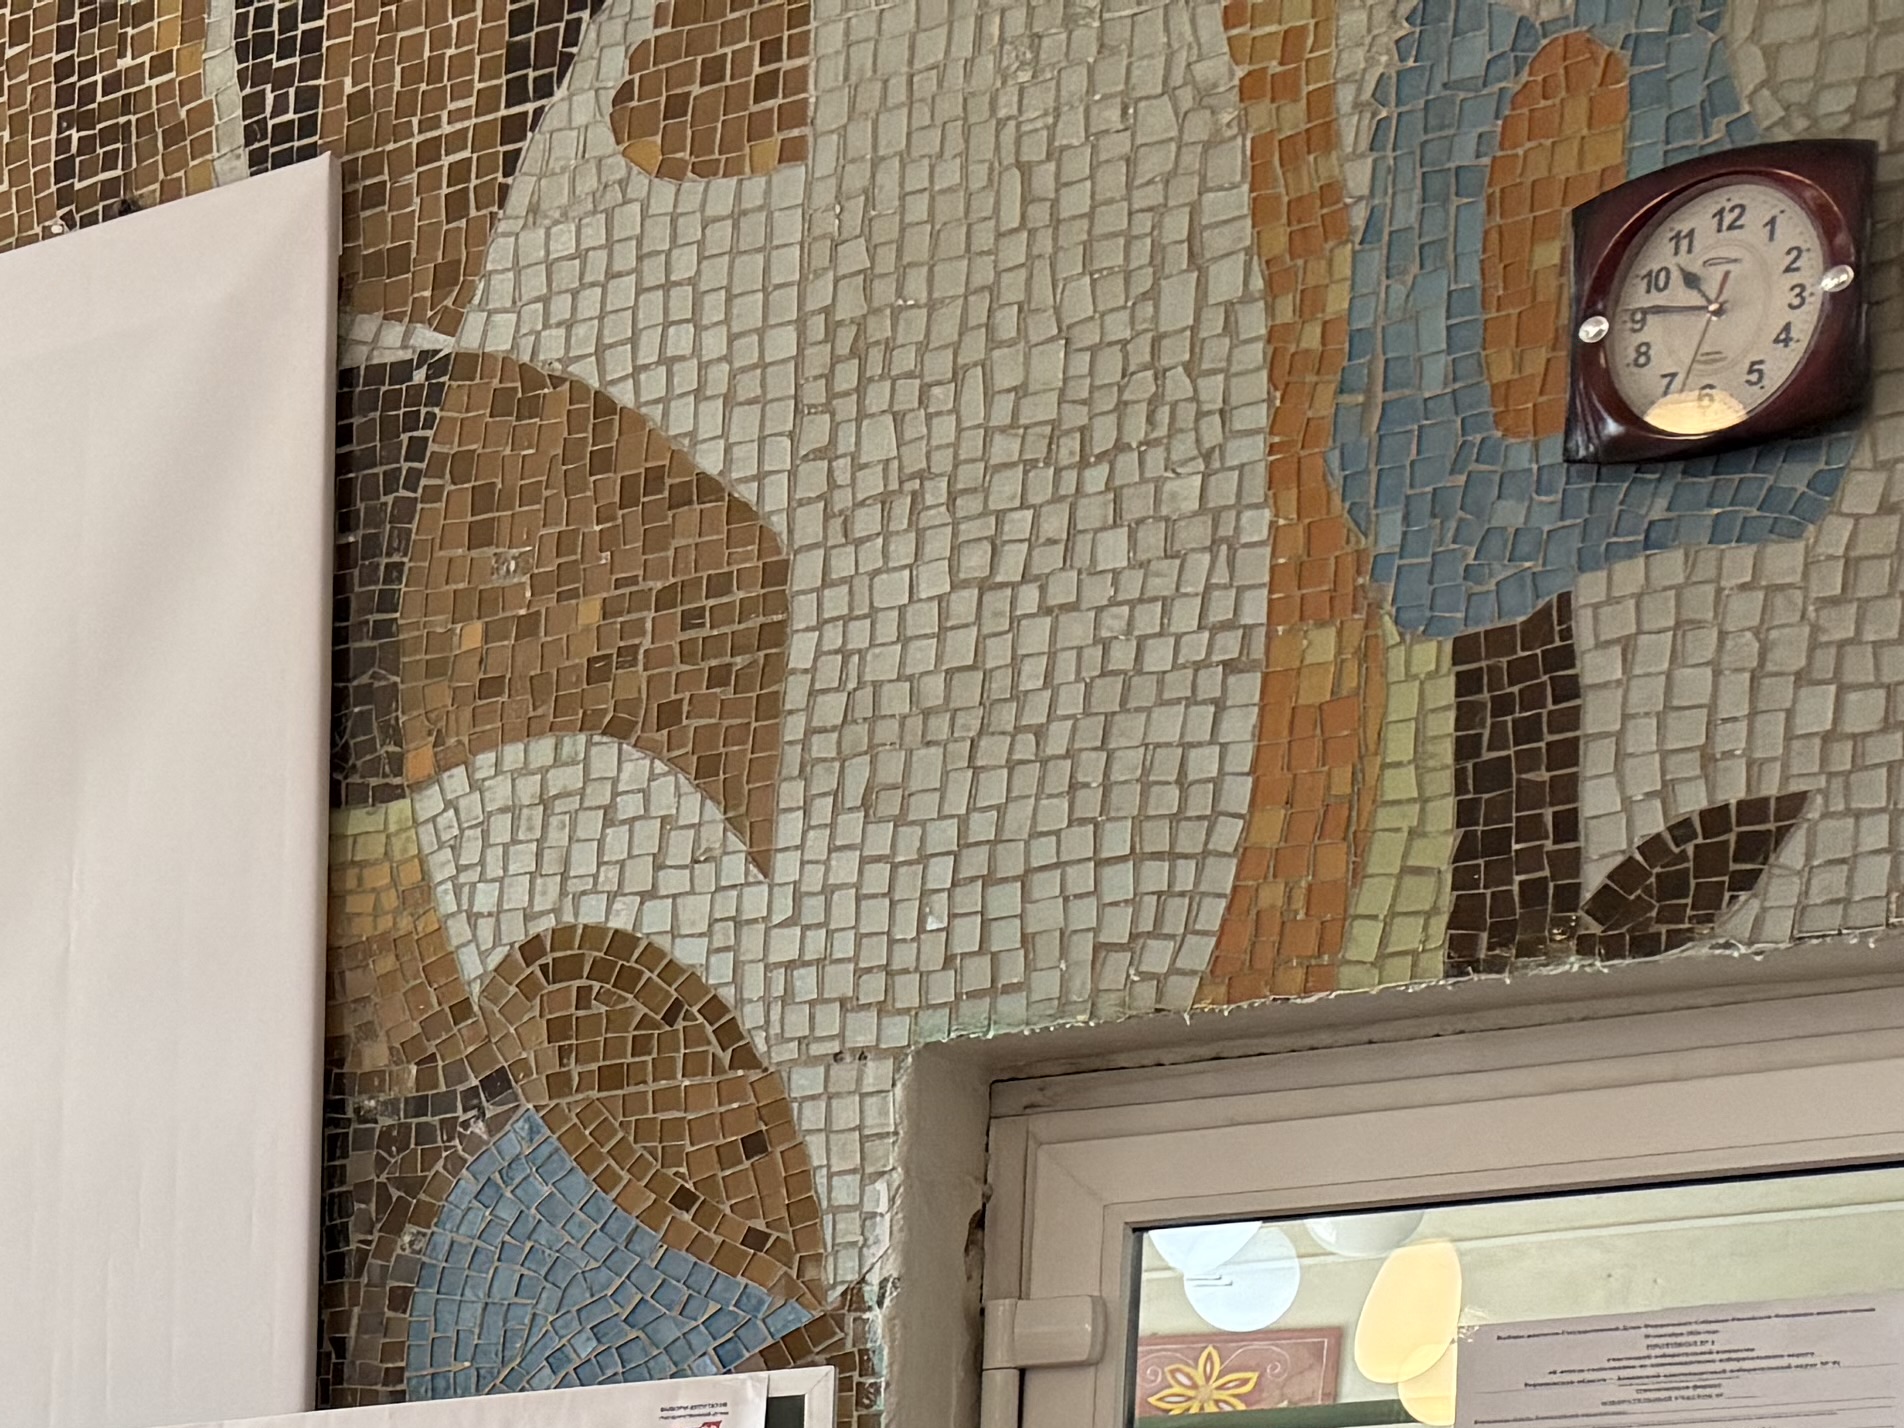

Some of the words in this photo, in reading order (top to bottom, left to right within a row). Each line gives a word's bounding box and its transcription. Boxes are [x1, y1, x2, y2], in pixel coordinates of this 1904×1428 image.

[1712, 203, 1747, 233] 12
[1762, 215, 1778, 242] 1
[1669, 227, 1696, 256] 11
[1782, 246, 1804, 274] 2
[1641, 266, 1672, 293] 10
[1787, 283, 1807, 310] 3
[1628, 309, 1648, 333] 9
[1772, 321, 1794, 348] 4
[1632, 342, 1652, 368] 8
[1660, 372, 1679, 397] 7
[1745, 359, 1767, 386] 5
[1697, 383, 1717, 409] 6
